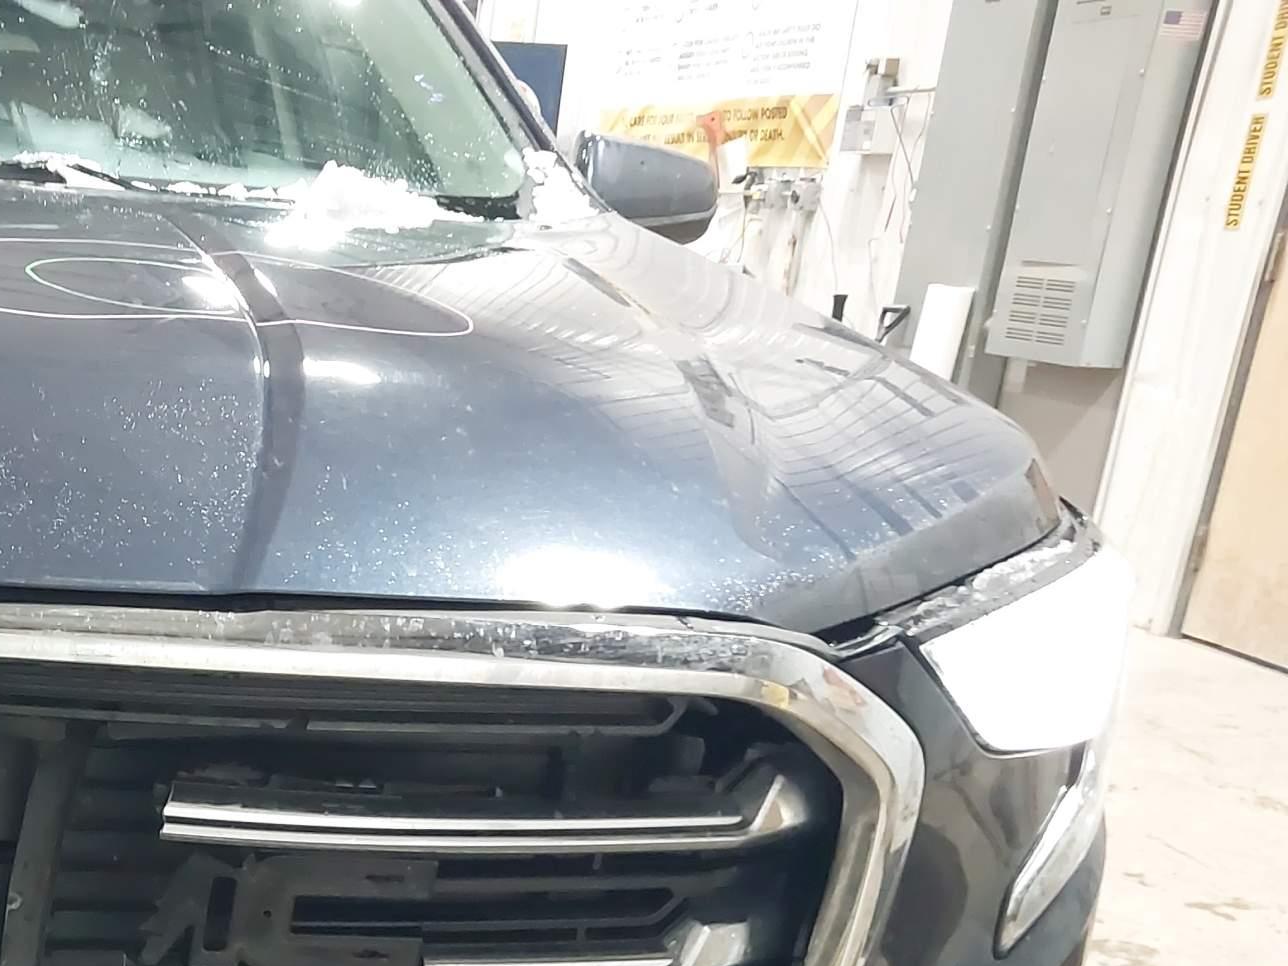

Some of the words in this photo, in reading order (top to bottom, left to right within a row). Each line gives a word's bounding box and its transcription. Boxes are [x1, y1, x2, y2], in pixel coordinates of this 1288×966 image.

[1259, 35, 1284, 96] STUDENT
[760, 106, 788, 120] POSTED
[1226, 169, 1250, 227] STUDENT
[1241, 115, 1265, 164] DRIVER
